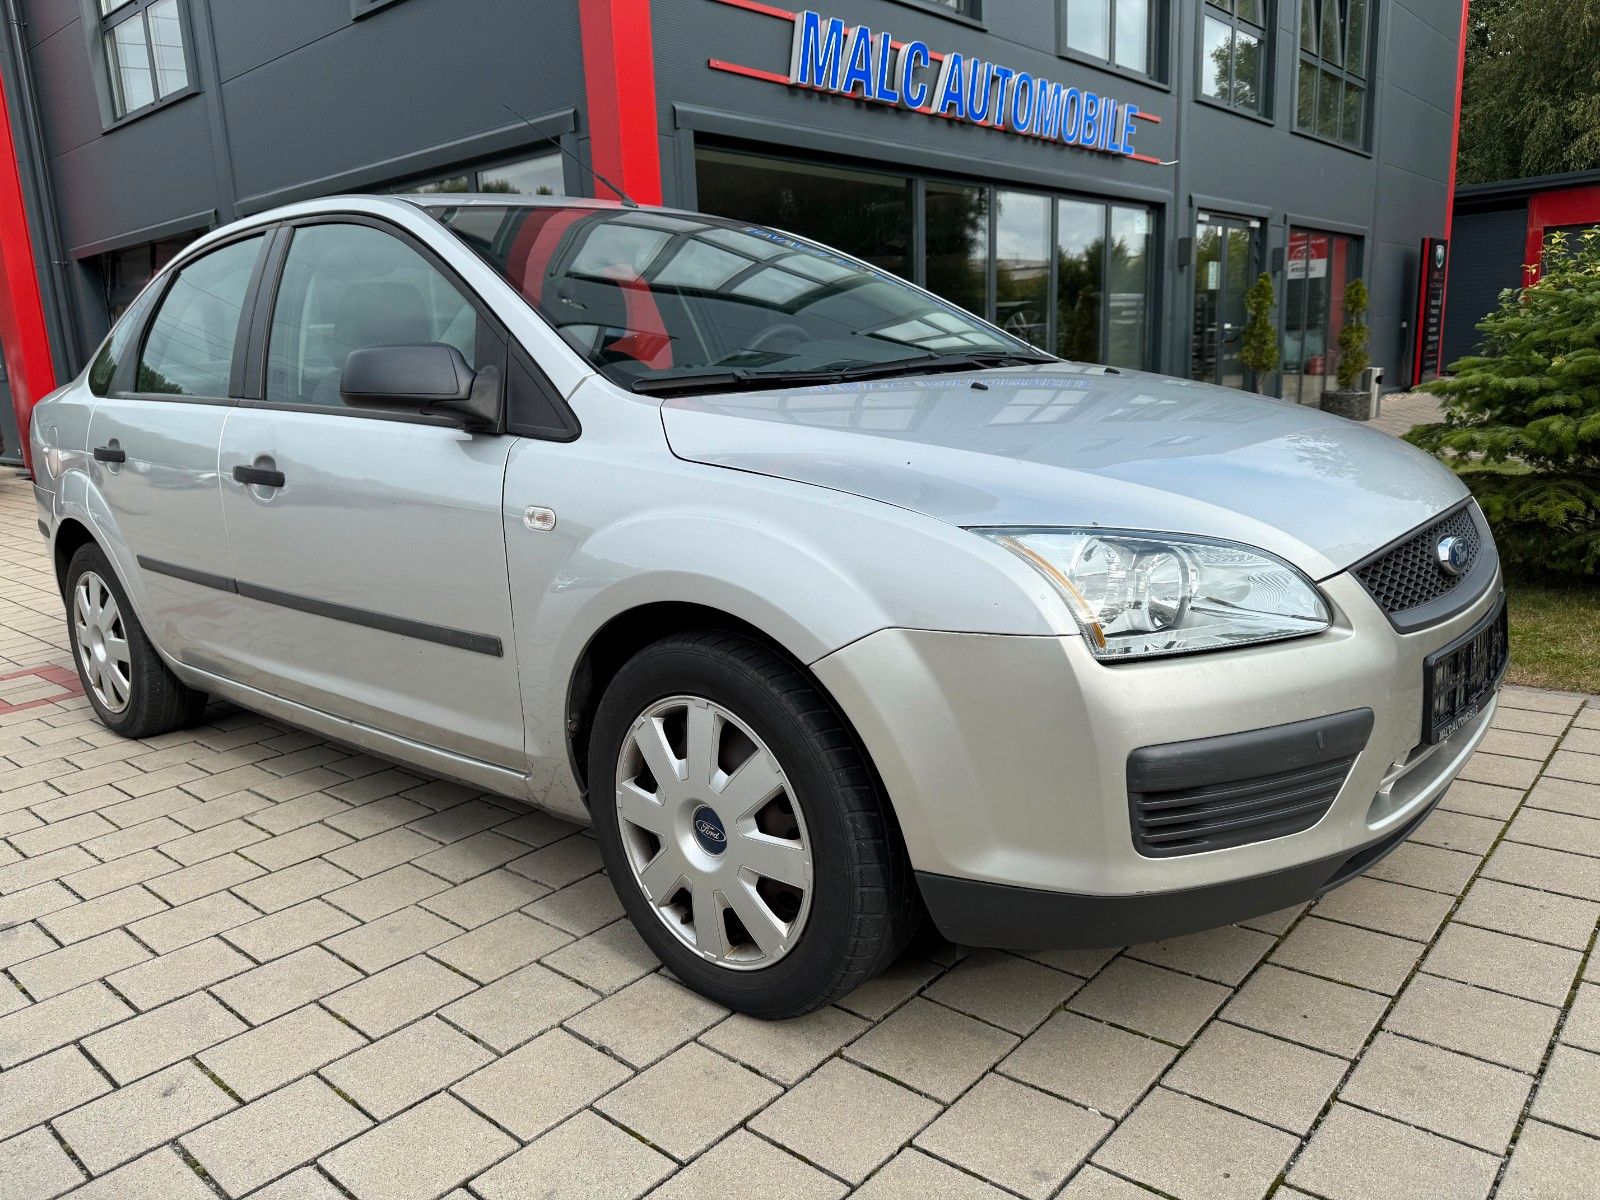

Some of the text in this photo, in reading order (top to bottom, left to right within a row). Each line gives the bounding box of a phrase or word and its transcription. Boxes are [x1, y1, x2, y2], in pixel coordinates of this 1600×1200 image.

[798, 9, 1140, 156] MALC AUTOMOBILE
[700, 822, 721, 840] Ford
